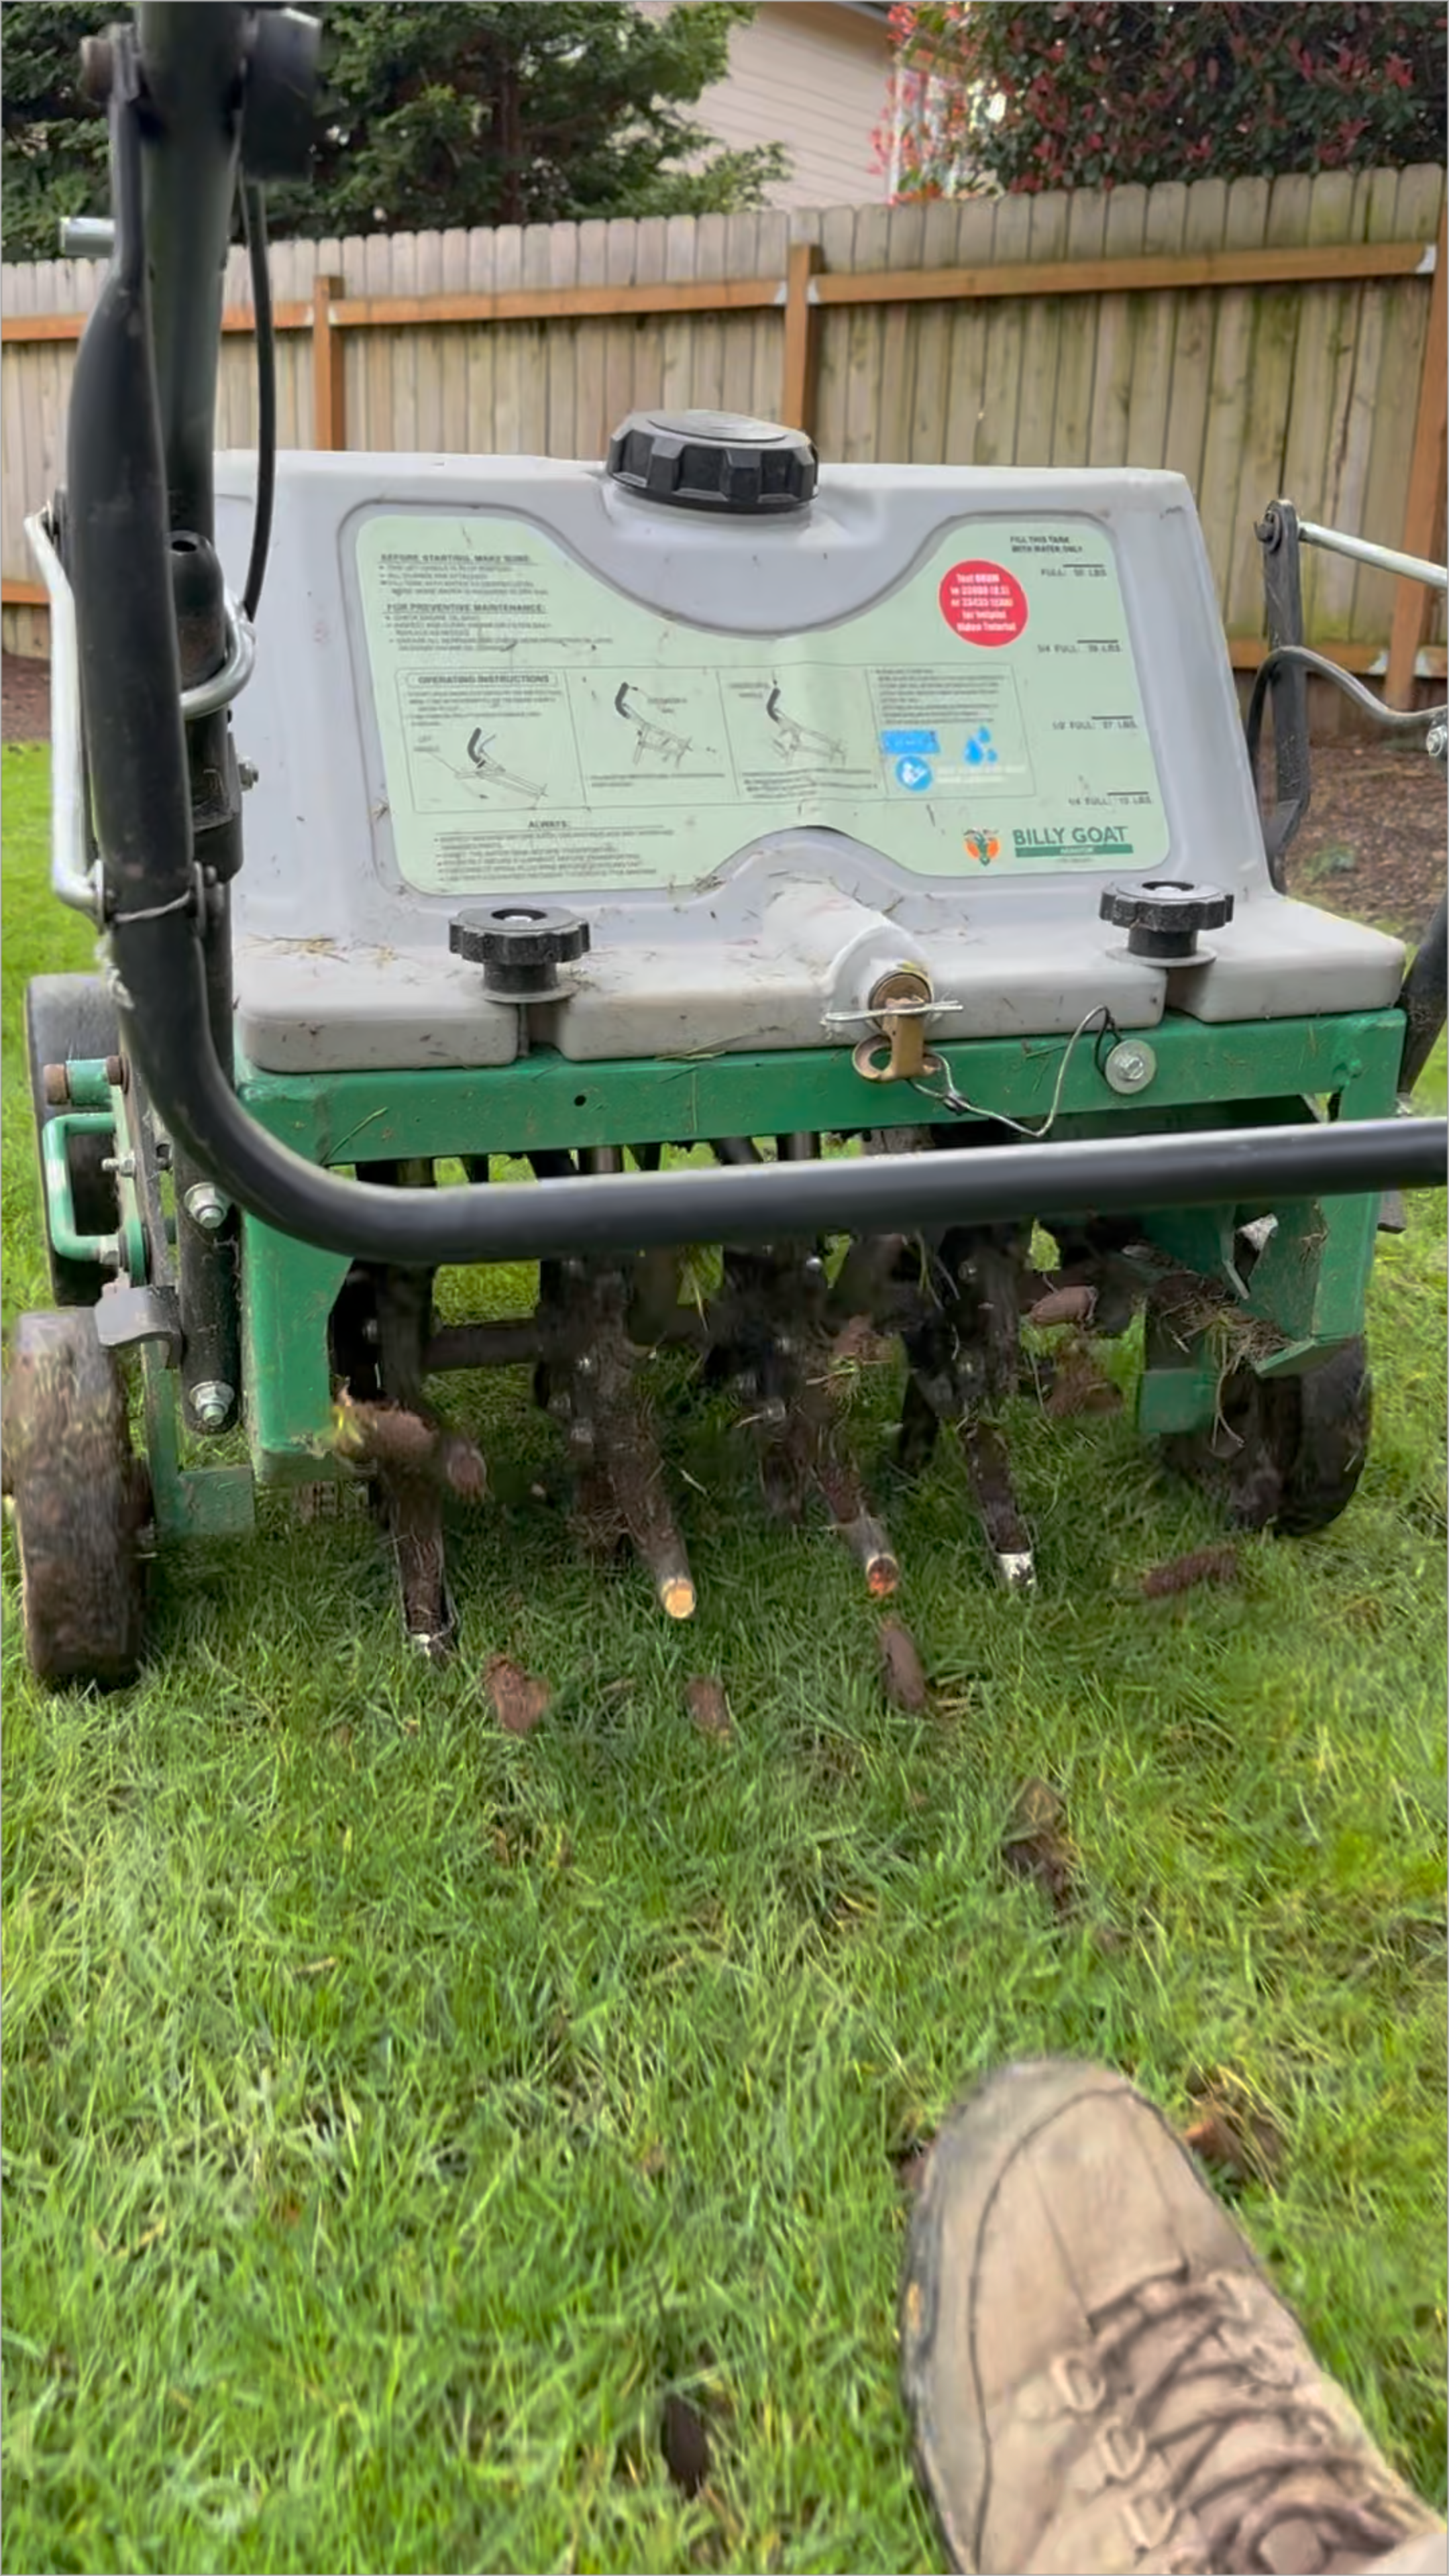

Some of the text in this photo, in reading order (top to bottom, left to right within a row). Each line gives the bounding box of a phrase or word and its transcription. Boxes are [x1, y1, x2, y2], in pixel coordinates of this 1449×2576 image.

[411, 604, 470, 612] PREVENTIVE
[417, 674, 550, 684] OPERATING INSTRUCTIONS
[1012, 825, 1129, 846] BILLY GOAT
